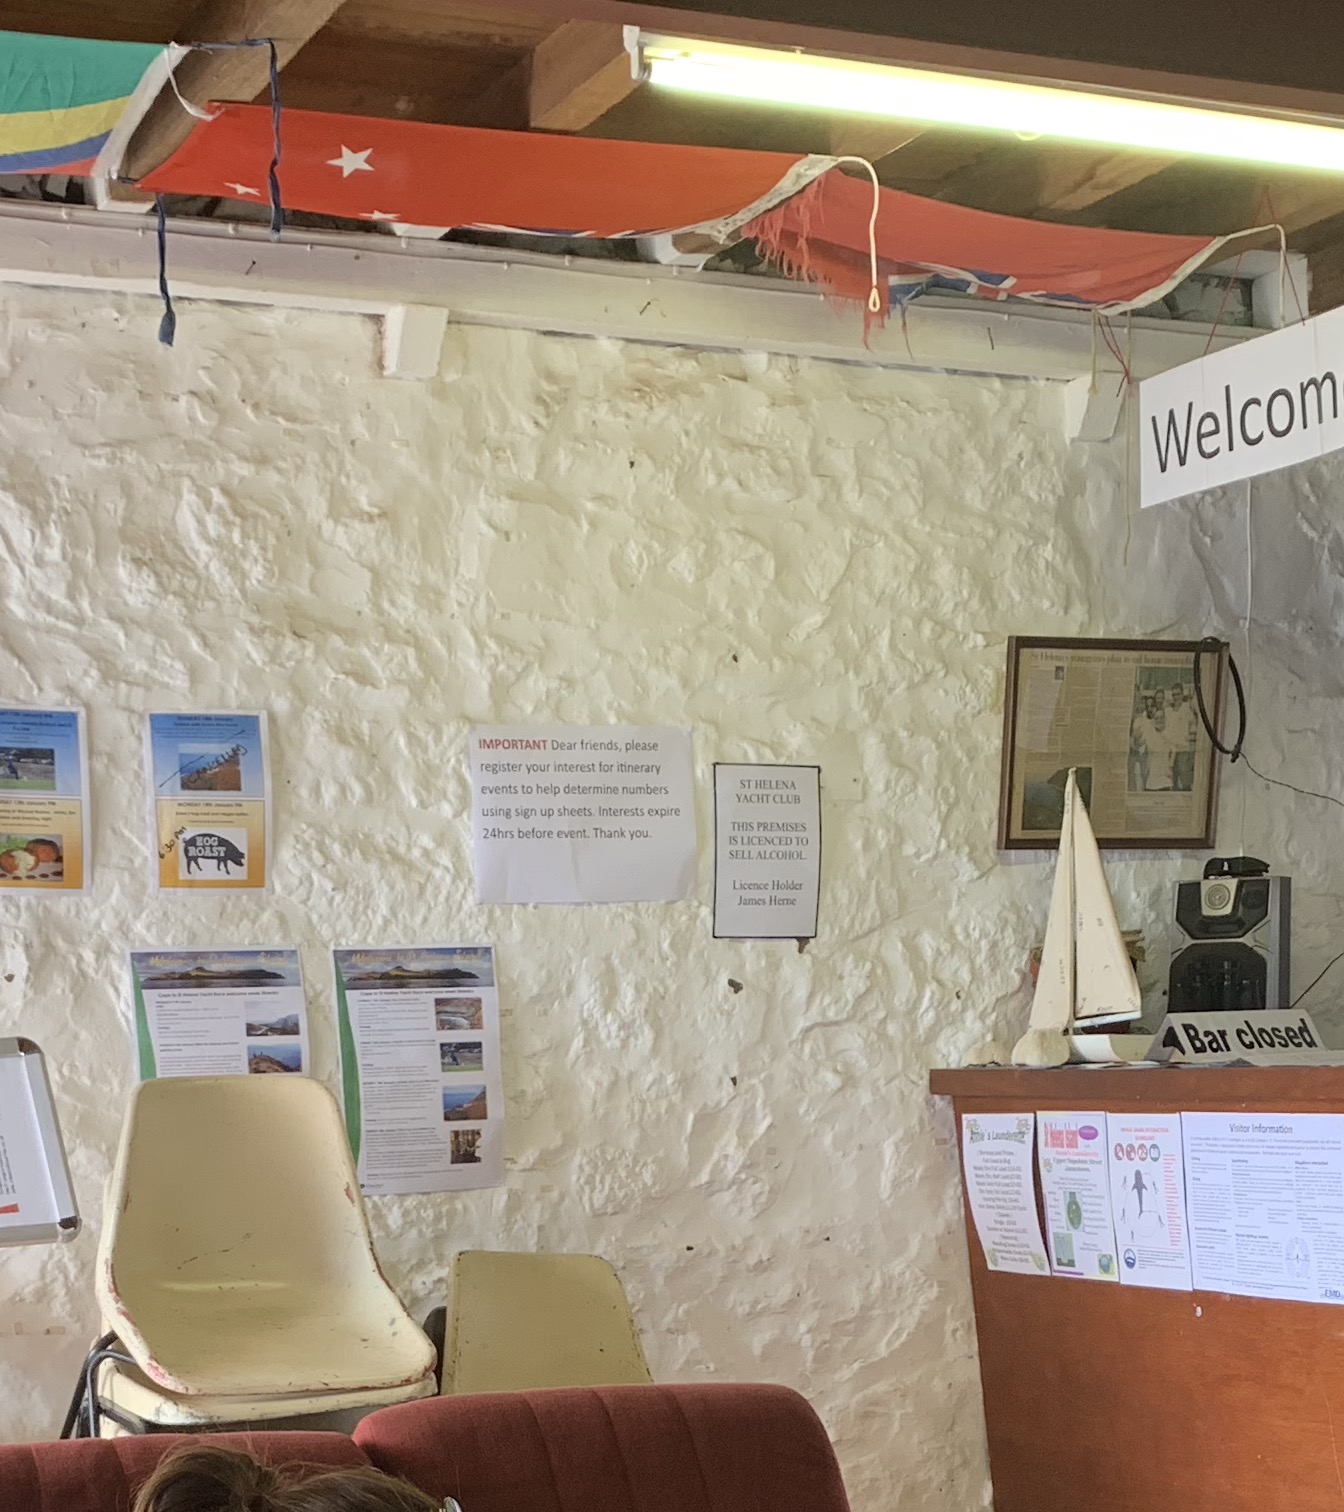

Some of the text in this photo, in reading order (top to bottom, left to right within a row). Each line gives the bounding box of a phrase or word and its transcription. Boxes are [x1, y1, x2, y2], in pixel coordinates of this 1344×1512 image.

[479, 738, 659, 753] IMPORTANT Dear friends, please
[480, 762, 661, 775] register your interest for itinerary
[740, 780, 796, 790] ST HELENA
[481, 784, 669, 797] events to help determine numbers
[735, 794, 801, 804] YACHT CLUB
[482, 806, 680, 819] using sign up sheets. Interests expire
[731, 822, 807, 832] THIS PREMISES
[483, 827, 652, 841] 24hrs before event. Thank you.
[196, 837, 219, 846] HOG
[729, 836, 808, 847] IS LICENCED TO
[188, 847, 226, 856] ROAST
[729, 851, 807, 860] SELL ALCOHOL.
[733, 880, 803, 891] Licence Holder
[738, 896, 766, 906] James
[1181, 1018, 1318, 1053] Bar closed
[1229, 1124, 1293, 1134] Visitor Information
